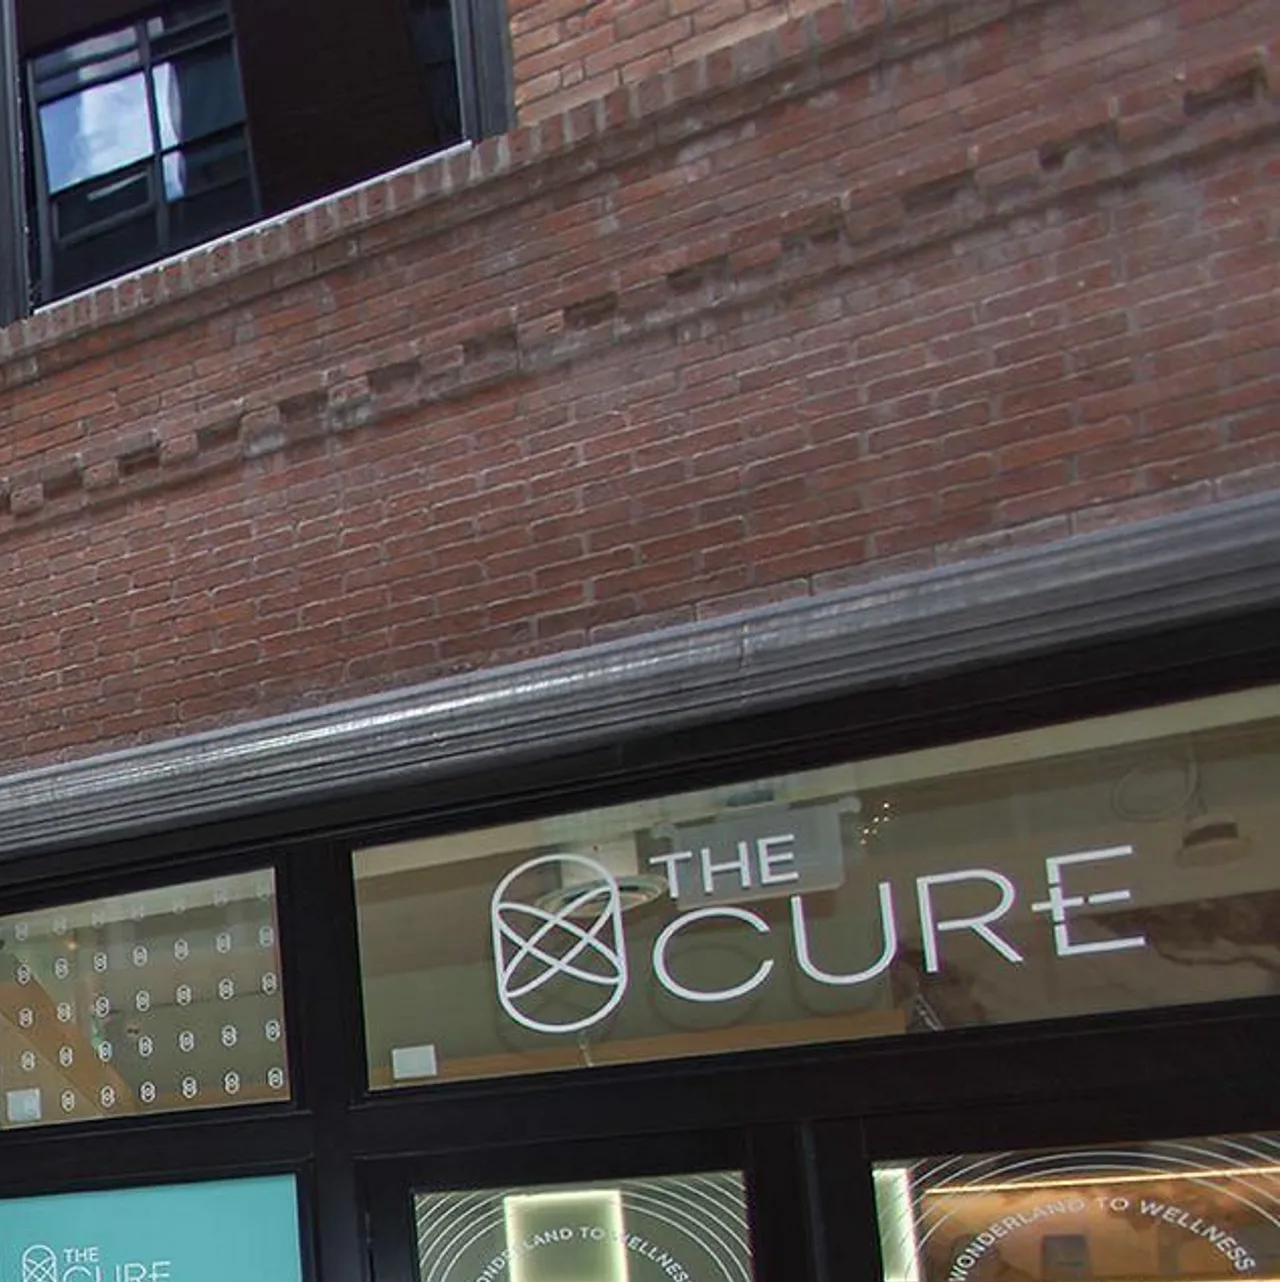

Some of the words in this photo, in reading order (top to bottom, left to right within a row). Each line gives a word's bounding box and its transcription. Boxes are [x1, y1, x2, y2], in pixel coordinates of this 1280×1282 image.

[649, 834, 800, 899] THE
[652, 845, 1146, 1002] CURE
[63, 1247, 99, 1263] THE
[580, 1226, 605, 1240] TO
[1096, 1198, 1130, 1211] TO
[1140, 1199, 1256, 1272] WELLNESS
